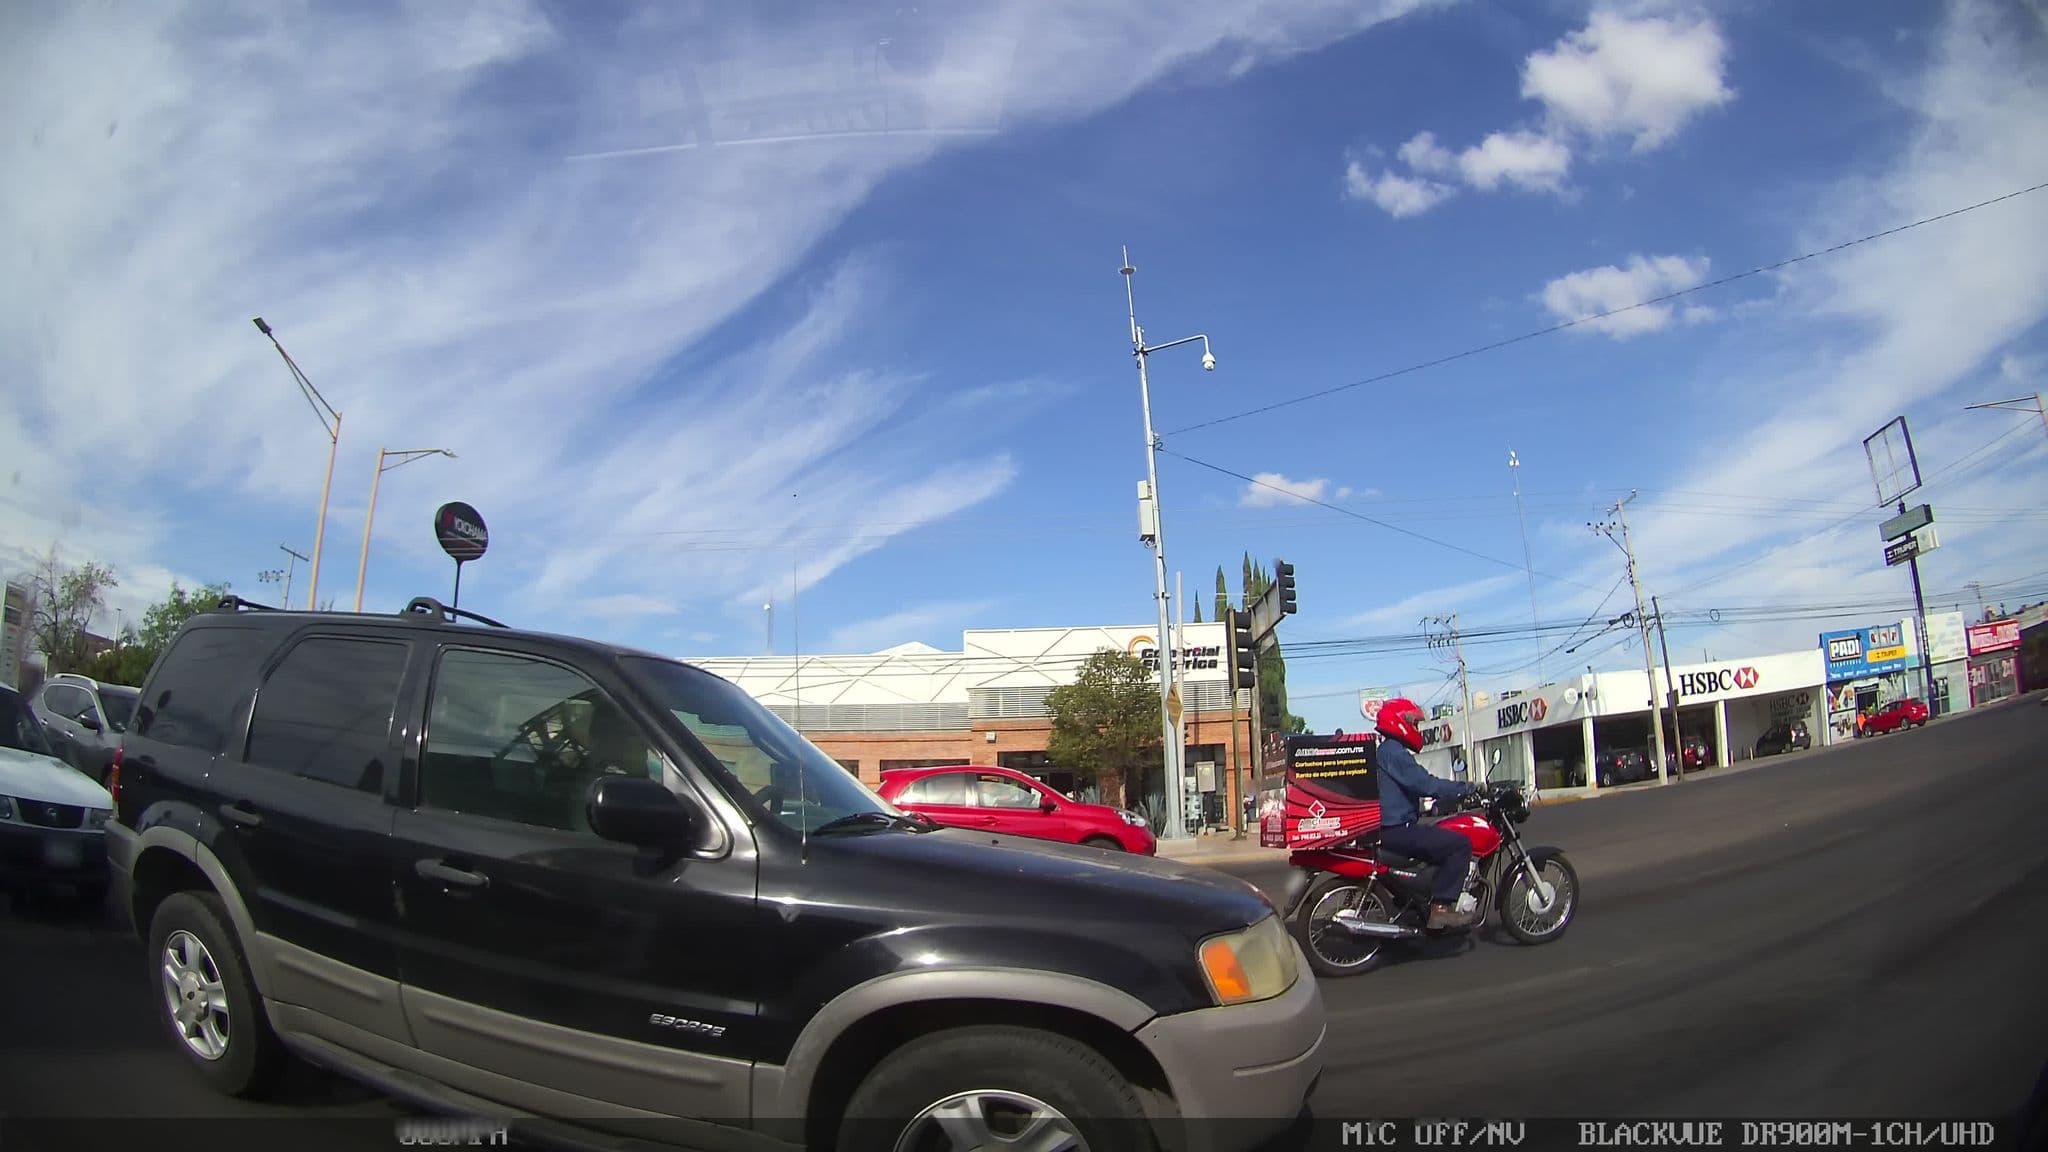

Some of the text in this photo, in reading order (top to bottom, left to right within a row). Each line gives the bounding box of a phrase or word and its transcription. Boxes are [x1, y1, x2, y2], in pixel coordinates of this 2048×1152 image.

[1830, 639, 1860, 657] PADI
[1679, 669, 1733, 697] HSBC
[1497, 701, 1529, 729] HSBC
[649, 1013, 727, 1038] ESCAPE
